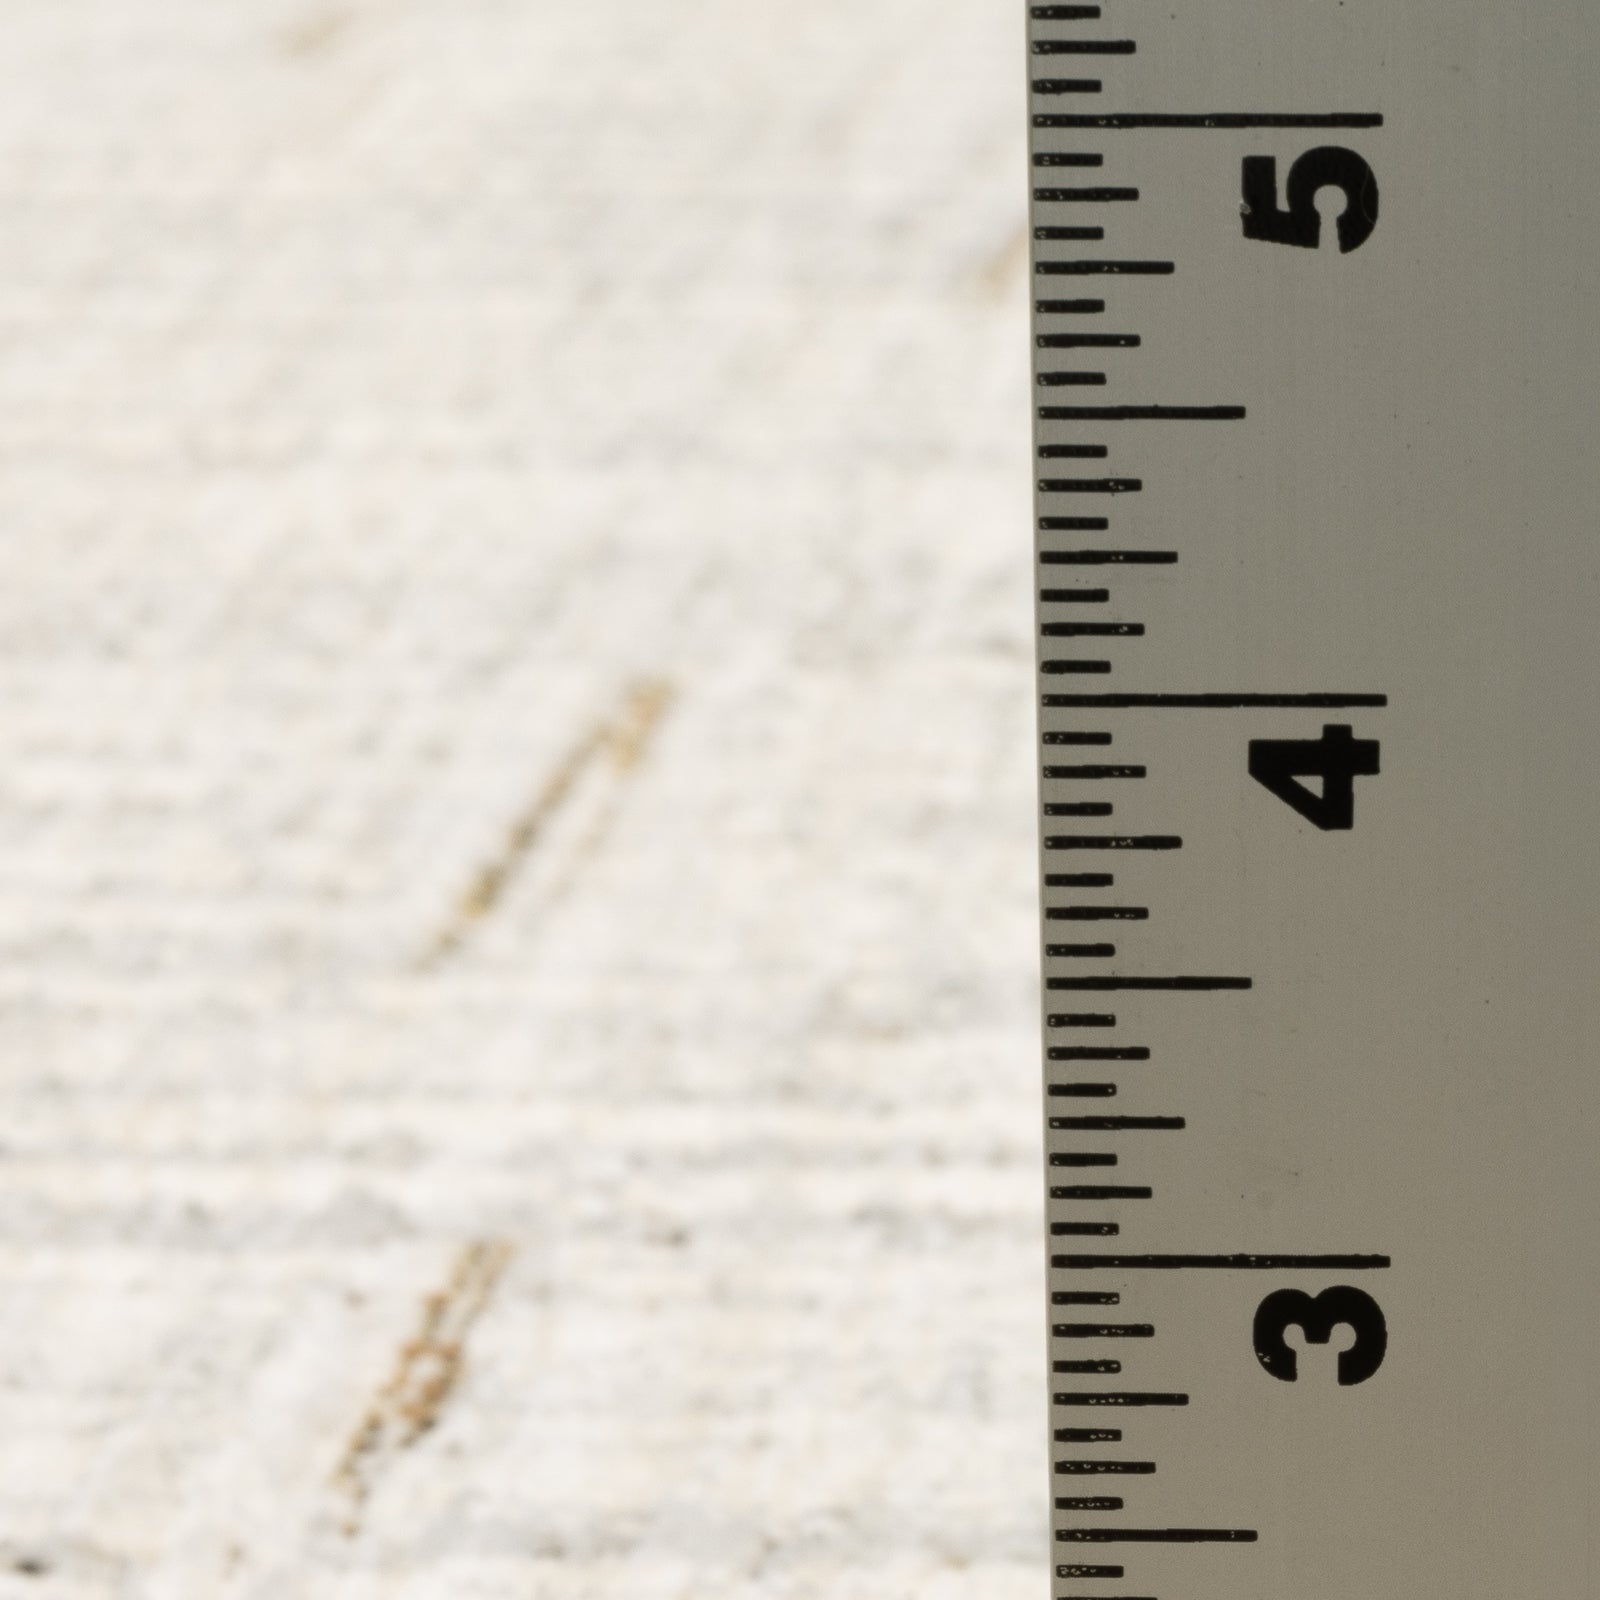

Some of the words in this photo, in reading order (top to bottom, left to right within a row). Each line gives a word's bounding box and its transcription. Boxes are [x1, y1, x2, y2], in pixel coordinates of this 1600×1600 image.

[1238, 144, 1381, 256] 5
[1246, 722, 1382, 833] 4
[1251, 1283, 1389, 1388] 3
